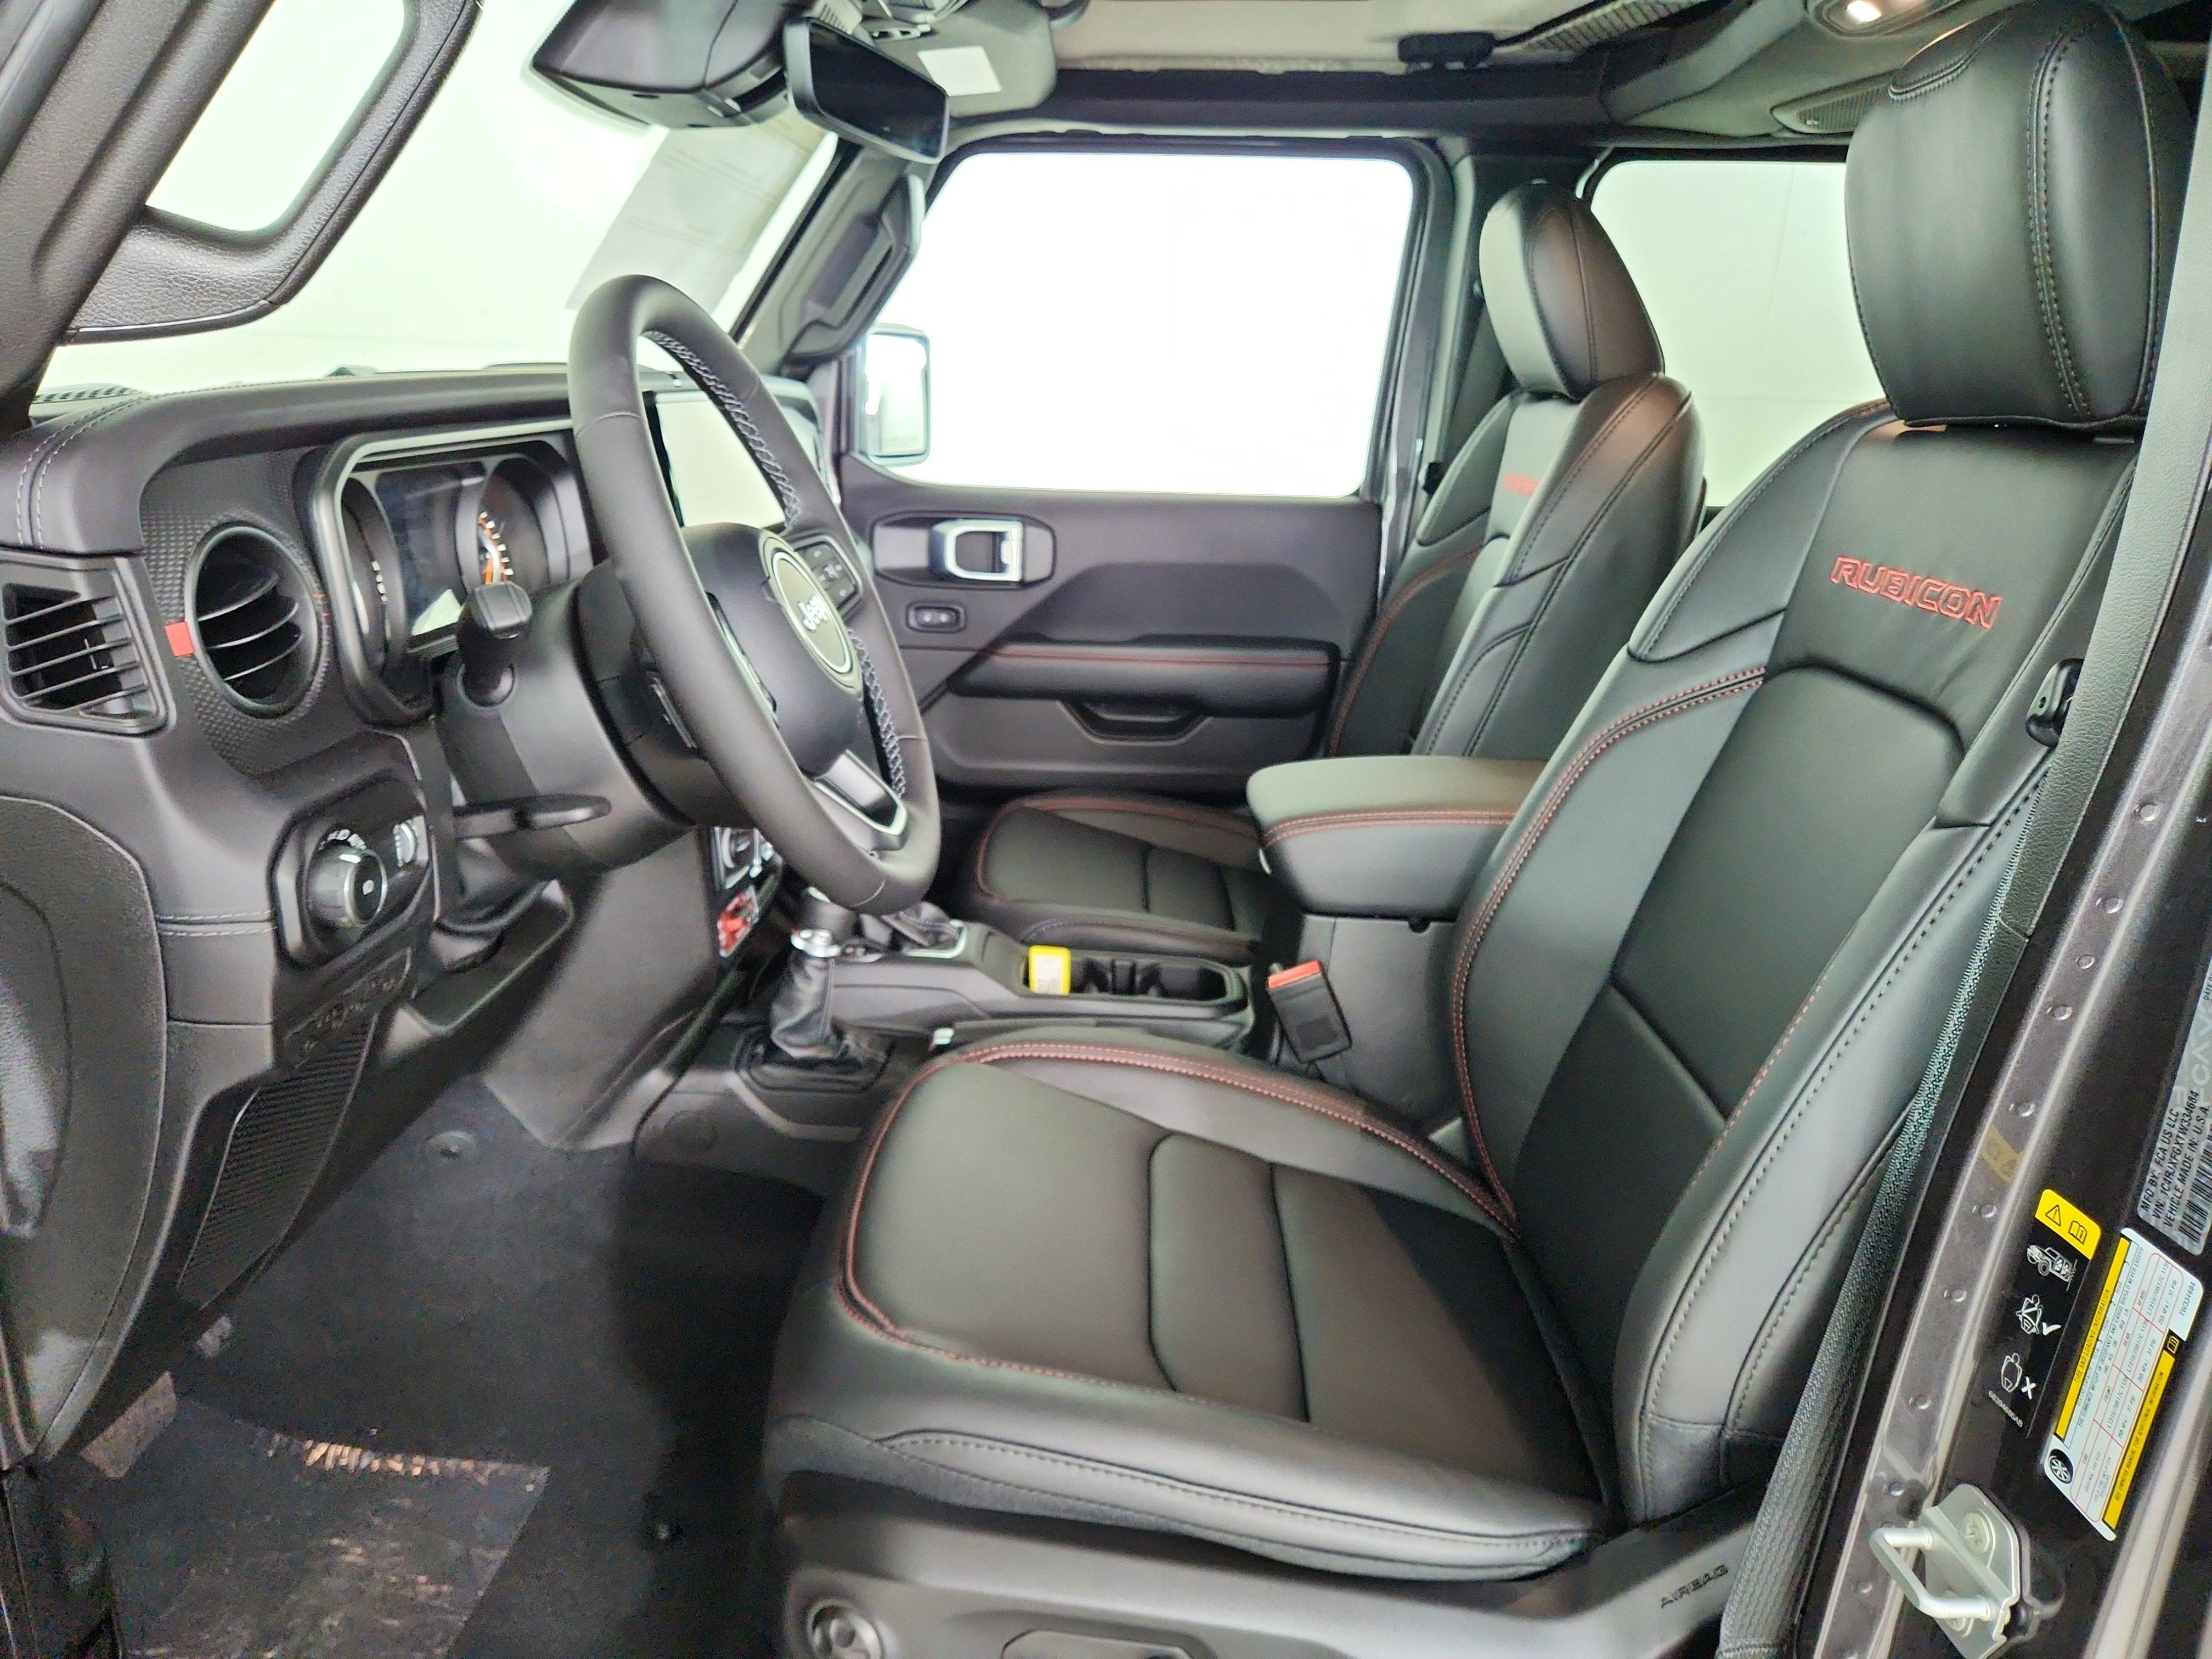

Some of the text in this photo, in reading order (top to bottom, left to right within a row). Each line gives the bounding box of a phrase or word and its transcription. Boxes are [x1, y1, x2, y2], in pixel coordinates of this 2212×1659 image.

[1831, 556, 2002, 629] RUBICON
[2191, 1102, 2210, 1136] U.S.A.
[2140, 1109, 2180, 1212] MFD BY: FCA US LLC
[2186, 1136, 2199, 1153] IN:
[2176, 1153, 2194, 1185] MADE
[2151, 1197, 2166, 1221] VIN:
[2163, 1185, 2184, 1228] VEHICLE
[2137, 1289, 2146, 1307] SPARE
[2179, 1280, 2196, 1317] TW334684
[2074, 1368, 2082, 1384] TIRE
[2083, 1328, 2095, 1356] LOADING
[2092, 1287, 2110, 1330] INFORMATION
[2122, 1331, 2131, 1347] REAR
[1660, 1564, 1729, 1609] AIRBAG
